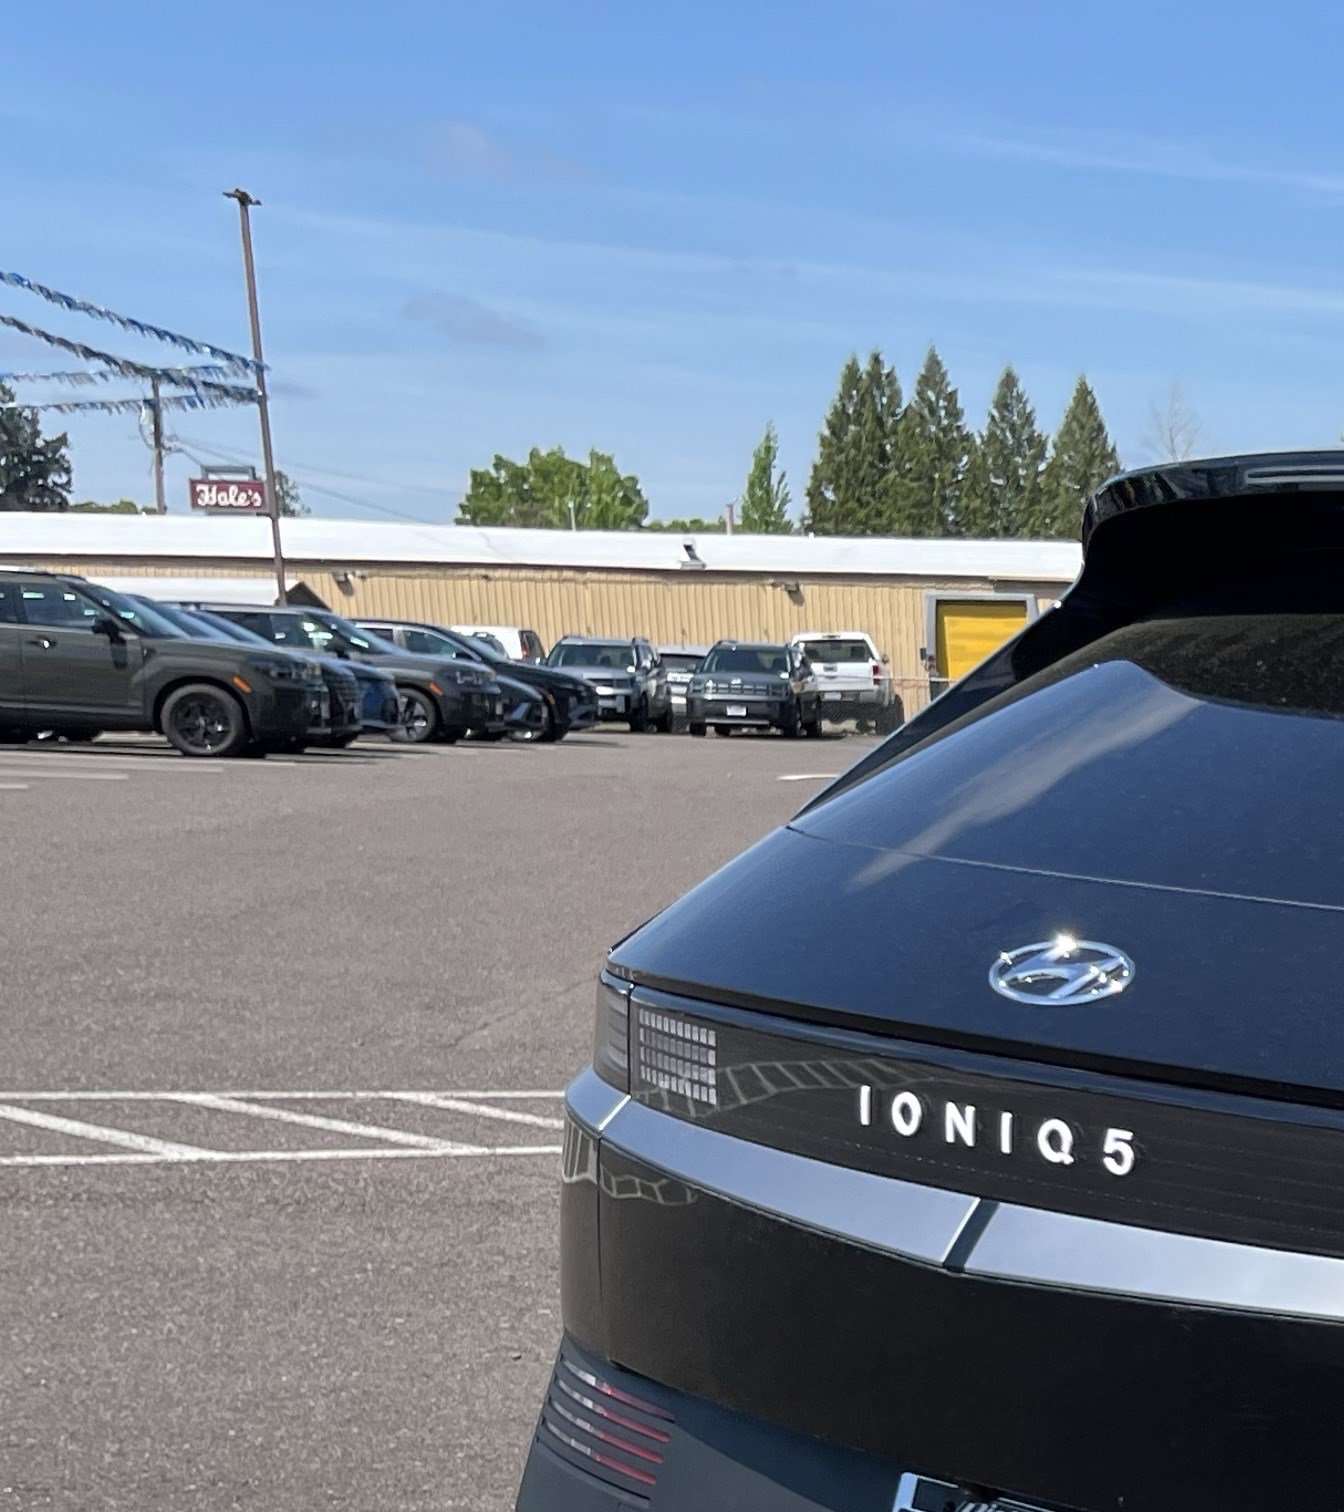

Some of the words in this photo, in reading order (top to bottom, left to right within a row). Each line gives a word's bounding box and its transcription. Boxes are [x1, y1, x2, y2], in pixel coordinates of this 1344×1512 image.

[196, 484, 263, 507] Hale's
[859, 1085, 1074, 1165] IONIQ
[1103, 1127, 1135, 1176] 5
